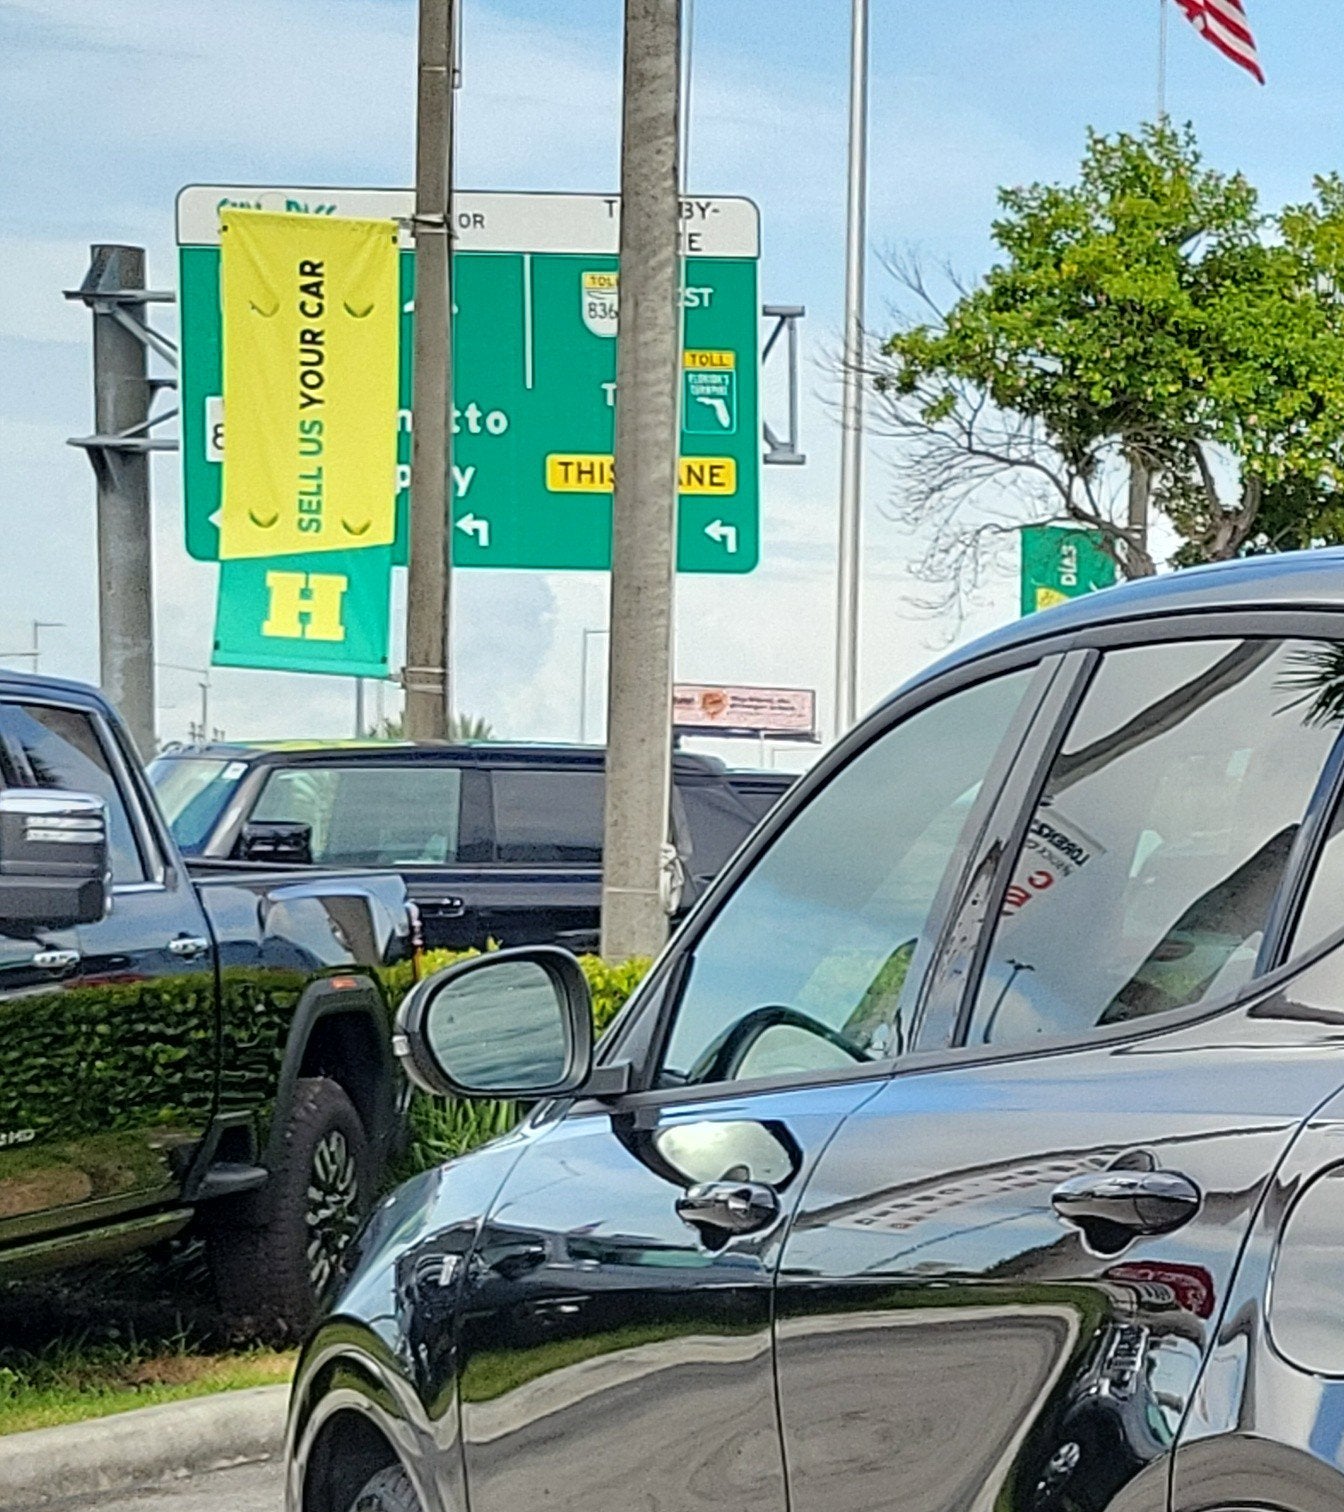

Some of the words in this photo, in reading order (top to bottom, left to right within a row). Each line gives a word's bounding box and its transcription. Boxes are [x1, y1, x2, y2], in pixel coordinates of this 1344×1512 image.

[299, 260, 325, 319] CAR
[680, 287, 714, 307] ST
[300, 329, 325, 410] YOUR
[690, 354, 729, 367] TOLL
[299, 420, 324, 456] US
[298, 466, 323, 533] SELL
[262, 571, 348, 641] H
